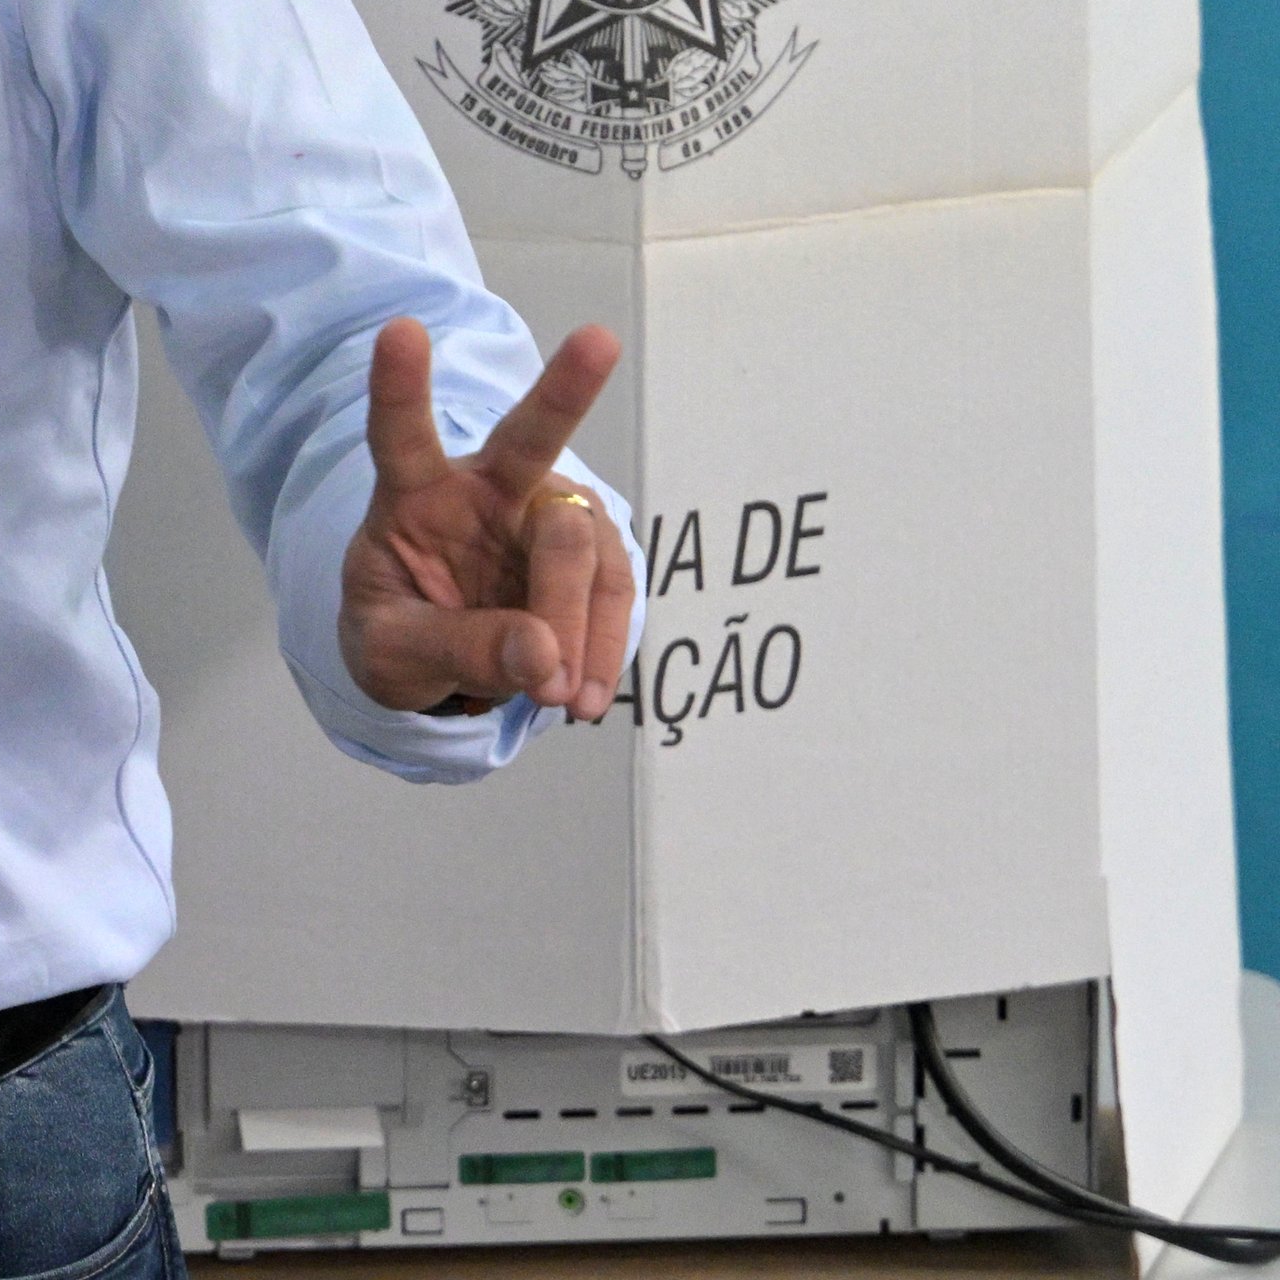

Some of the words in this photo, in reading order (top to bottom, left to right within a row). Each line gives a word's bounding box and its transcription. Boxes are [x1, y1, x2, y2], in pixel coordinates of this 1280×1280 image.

[580, 117, 674, 140] FEDERATIVA
[679, 106, 701, 127] DO
[705, 70, 753, 113] BRASIL
[731, 491, 828, 586] DE
